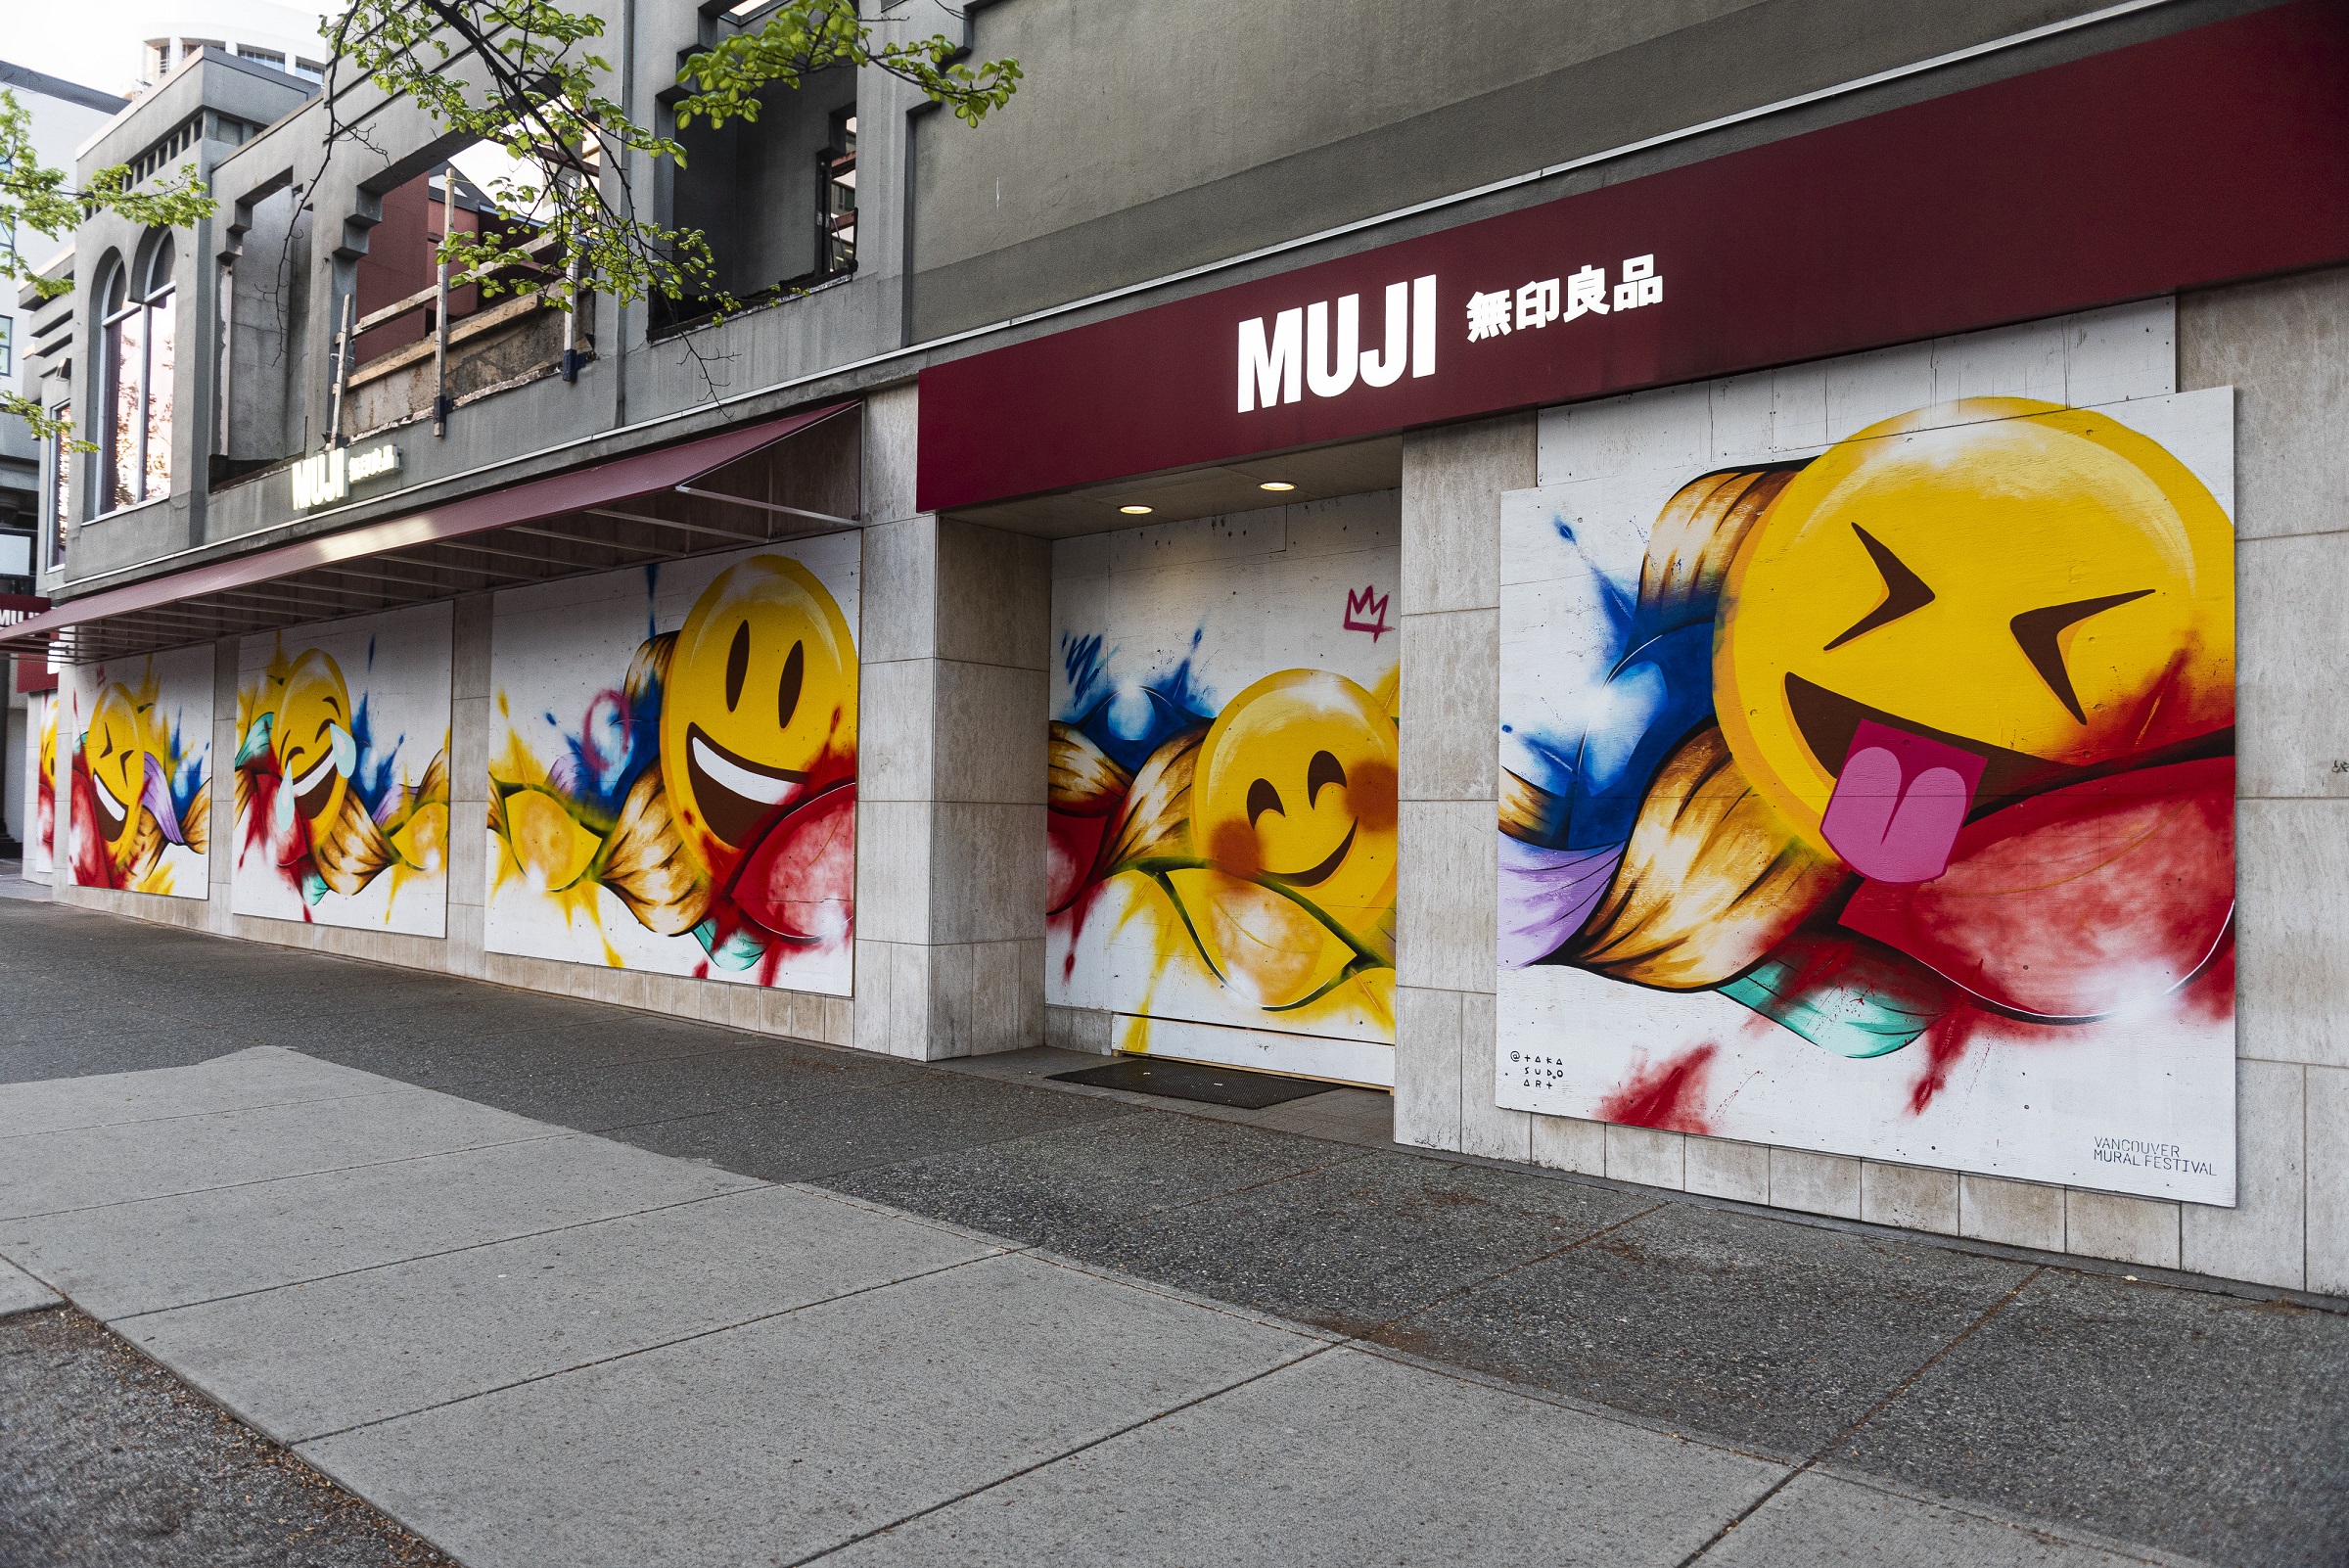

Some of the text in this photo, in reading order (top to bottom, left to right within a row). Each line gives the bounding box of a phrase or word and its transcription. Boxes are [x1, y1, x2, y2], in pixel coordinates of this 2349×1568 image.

[1466, 254, 1664, 343] 無印良品
[1237, 274, 1437, 414] MUJI
[292, 447, 345, 510] MUJI
[2094, 1135, 2181, 1158] VANCOUVER
[2094, 1148, 2218, 1176] MURAL FESTIVAL
